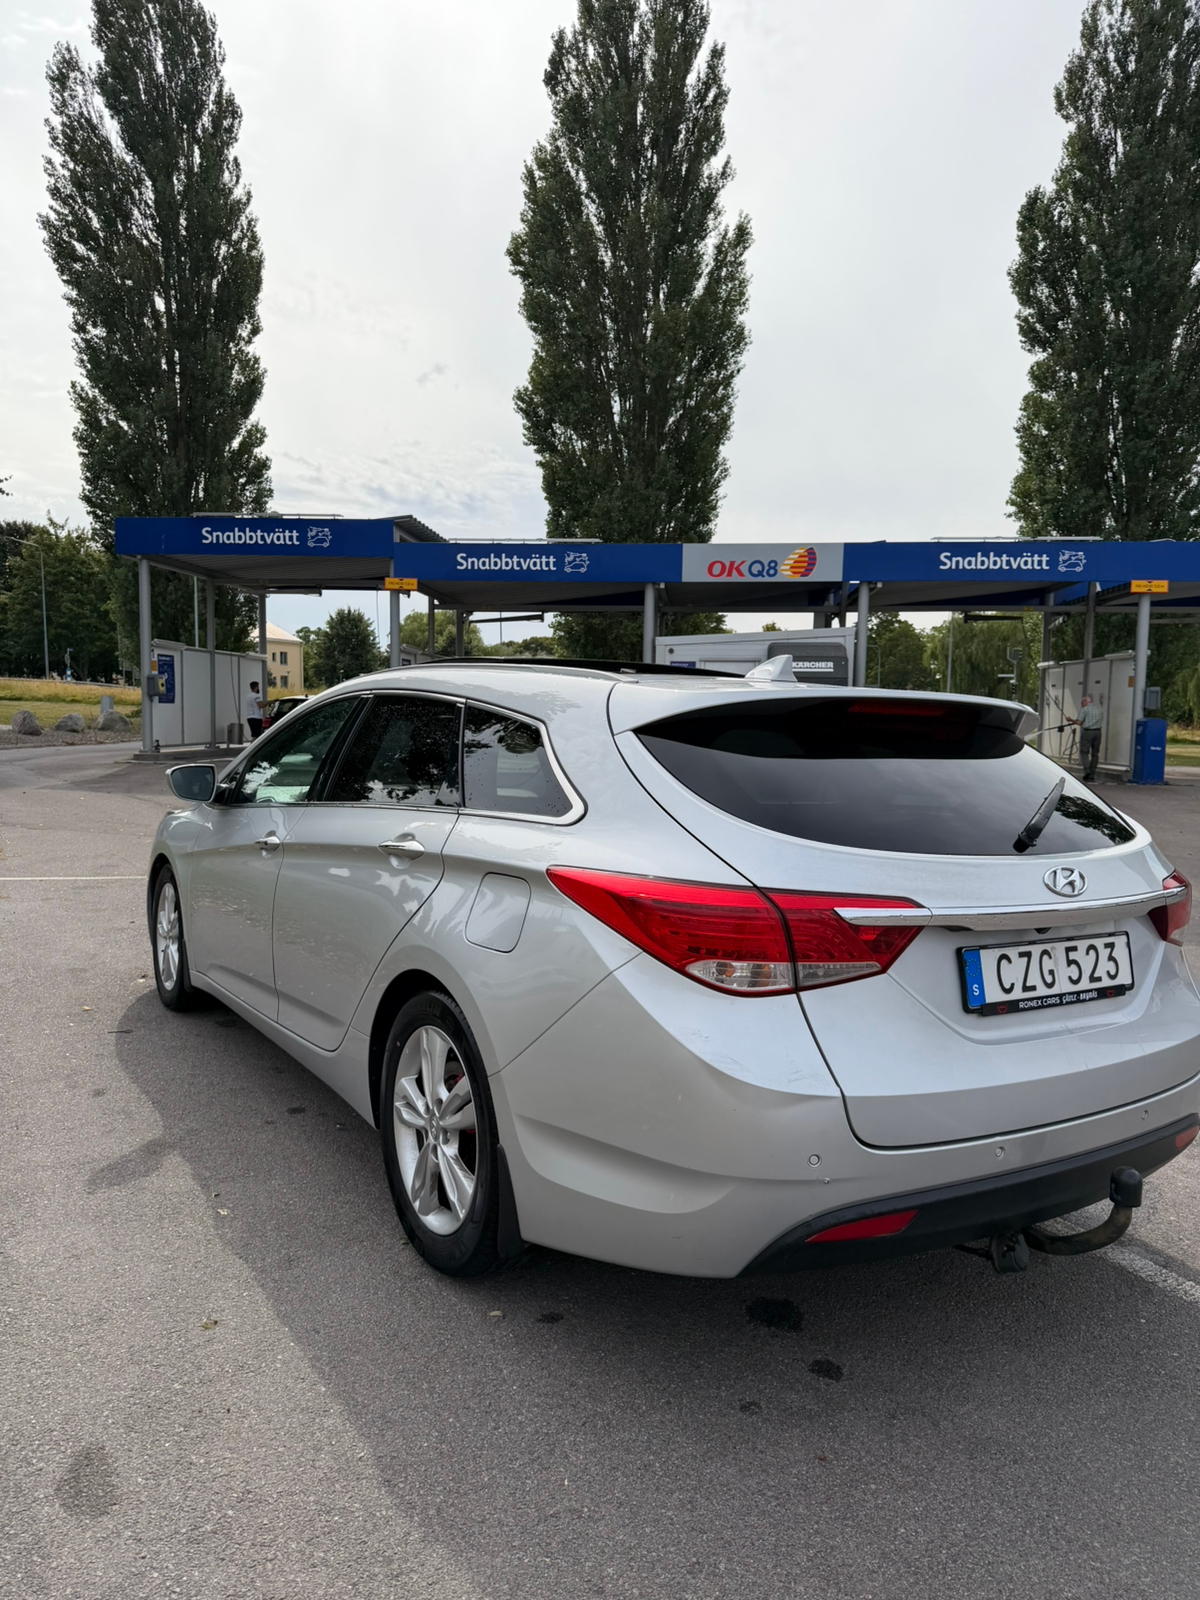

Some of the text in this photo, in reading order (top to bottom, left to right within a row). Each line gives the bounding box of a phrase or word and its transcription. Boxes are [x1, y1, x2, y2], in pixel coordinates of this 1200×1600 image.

[201, 526, 300, 545] Snabbtvätt
[456, 552, 557, 571] Snabbtvätt
[939, 551, 1050, 570] Snabbtvätt
[996, 942, 1119, 995] CZG 523
[973, 984, 980, 995] S
[1019, 998, 1042, 1009] RONEX
[1043, 996, 1060, 1006] CARS
